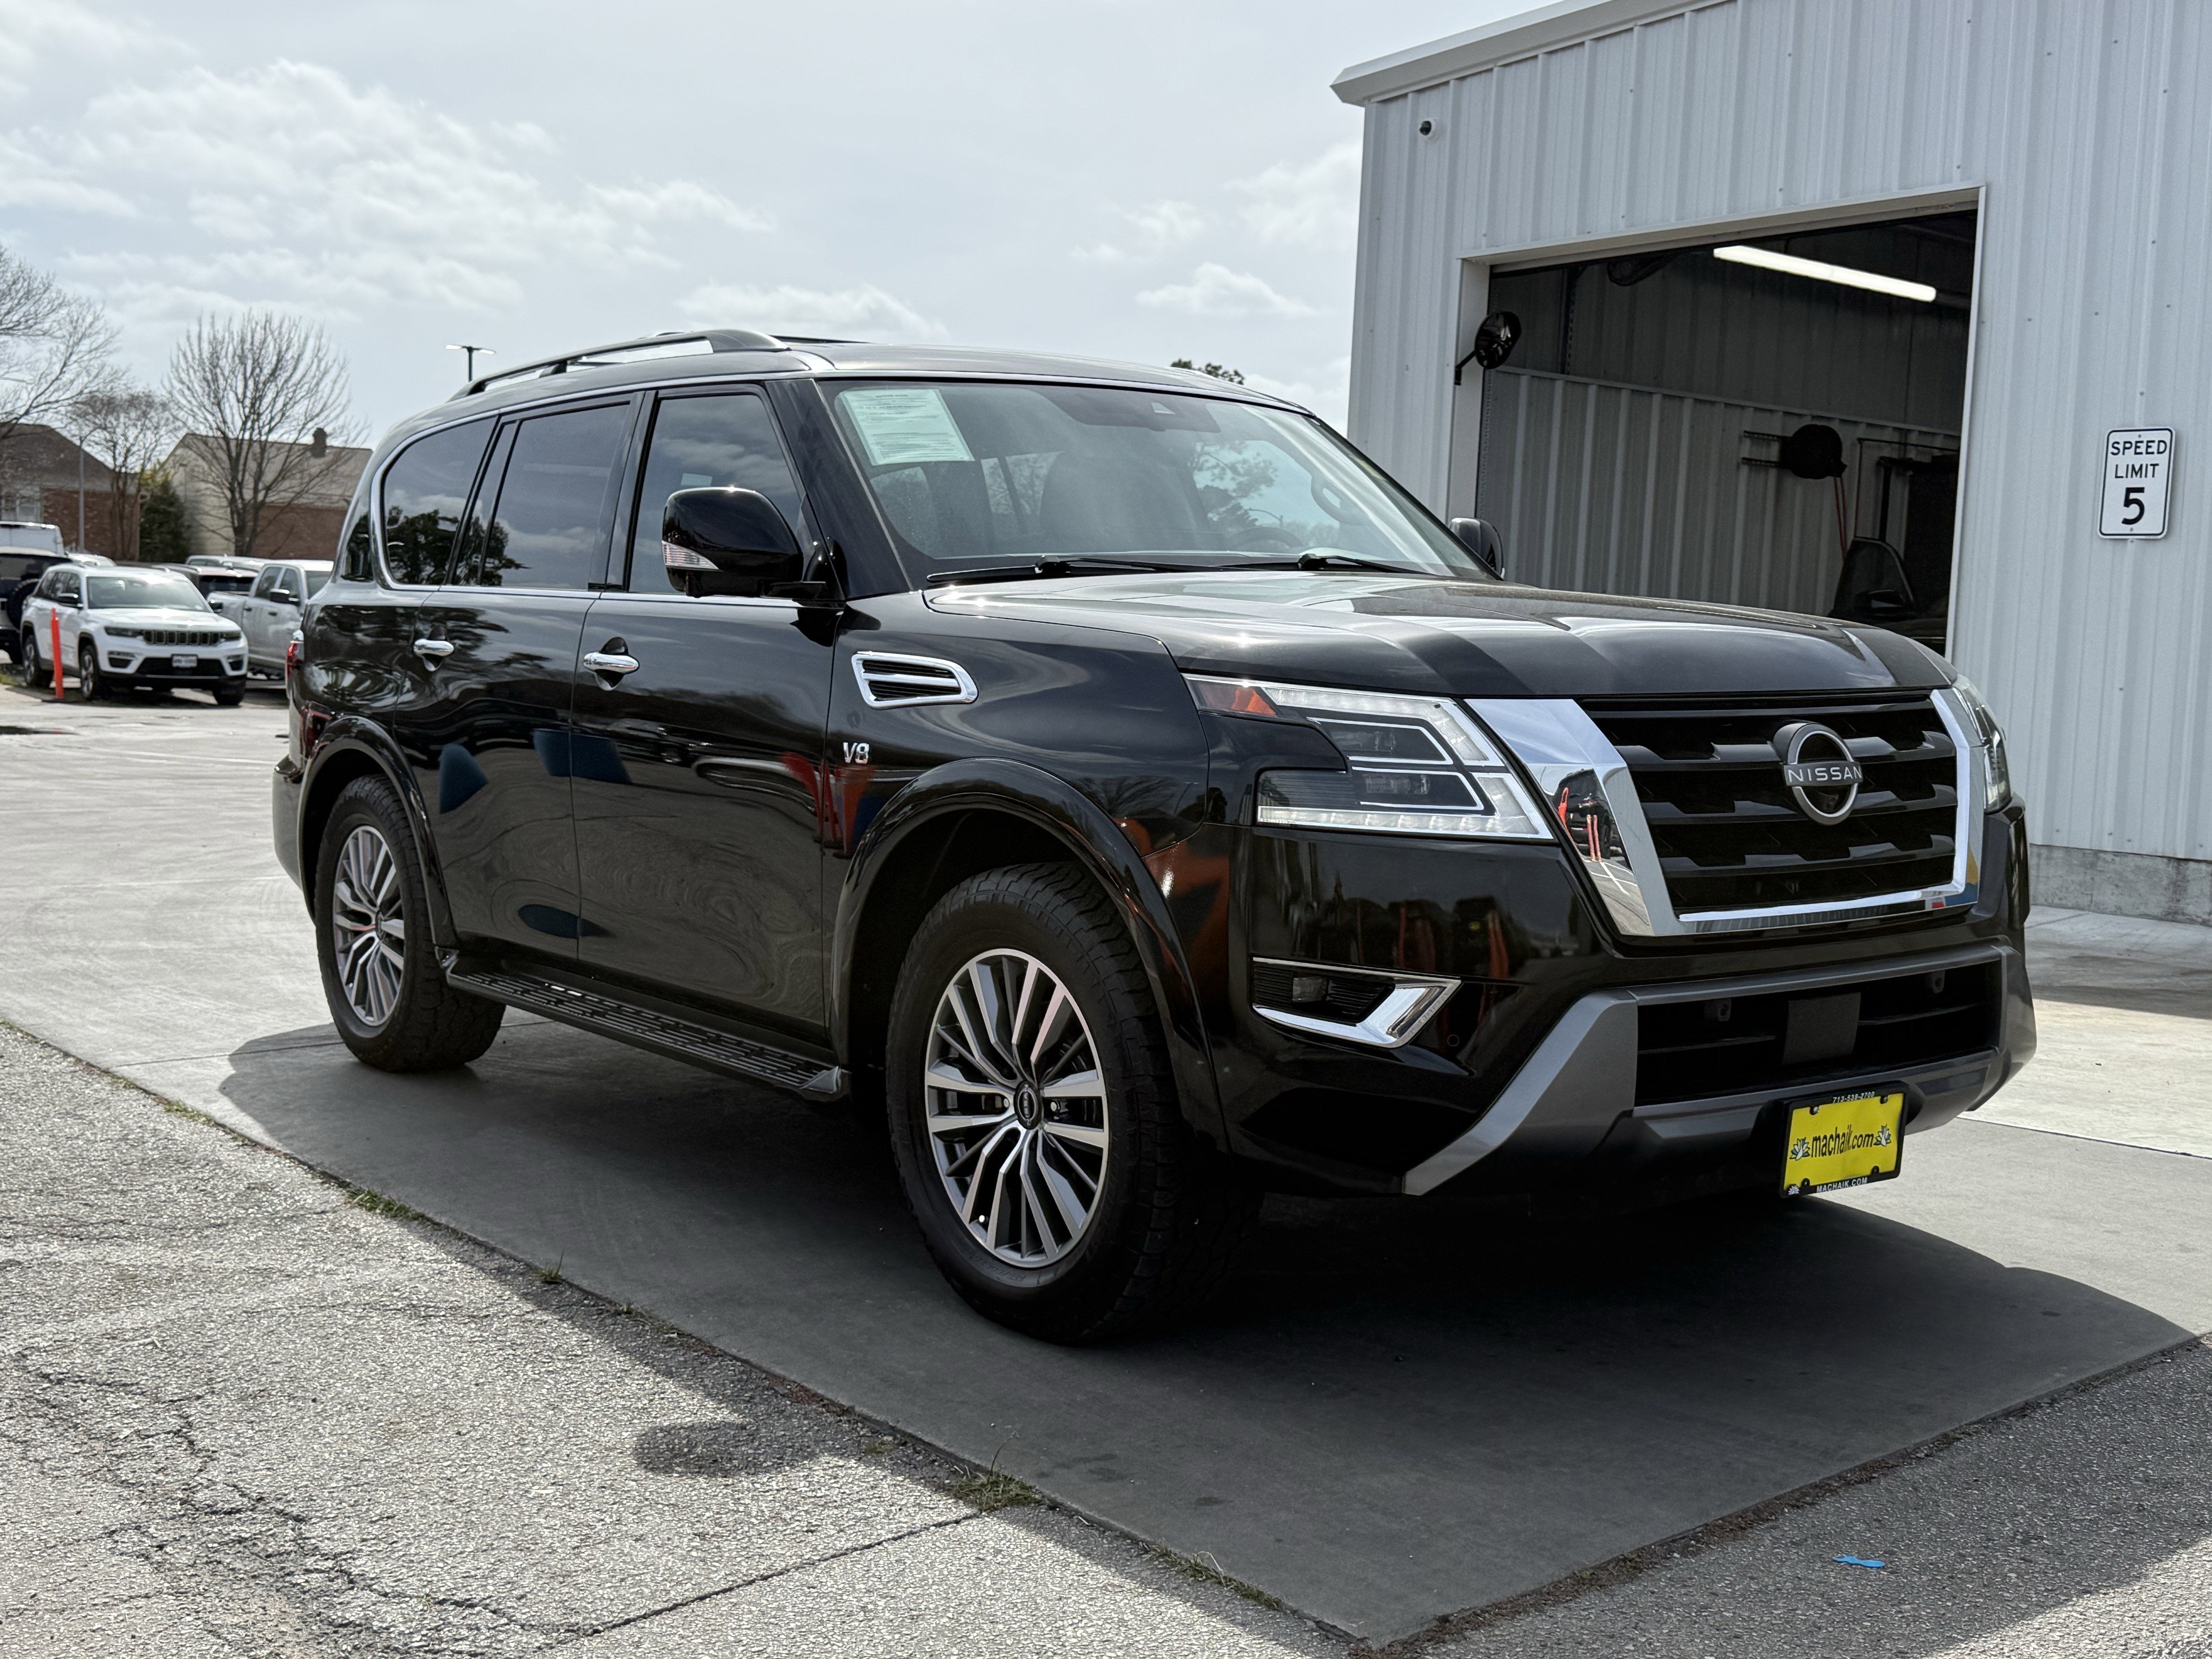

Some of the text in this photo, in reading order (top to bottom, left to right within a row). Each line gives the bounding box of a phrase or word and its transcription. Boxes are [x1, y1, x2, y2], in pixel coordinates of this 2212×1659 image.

[2111, 440, 2167, 455] SPEED
[2115, 464, 2159, 478] LIMIT
[2121, 487, 2145, 525] 5
[843, 742, 870, 764] V8
[1788, 766, 1862, 783] NISSAN
[1833, 1091, 1875, 1103] 713-538-2700
[1811, 1124, 1874, 1158] machaik.com
[1816, 1177, 1868, 1193] MACHAIK.COM
